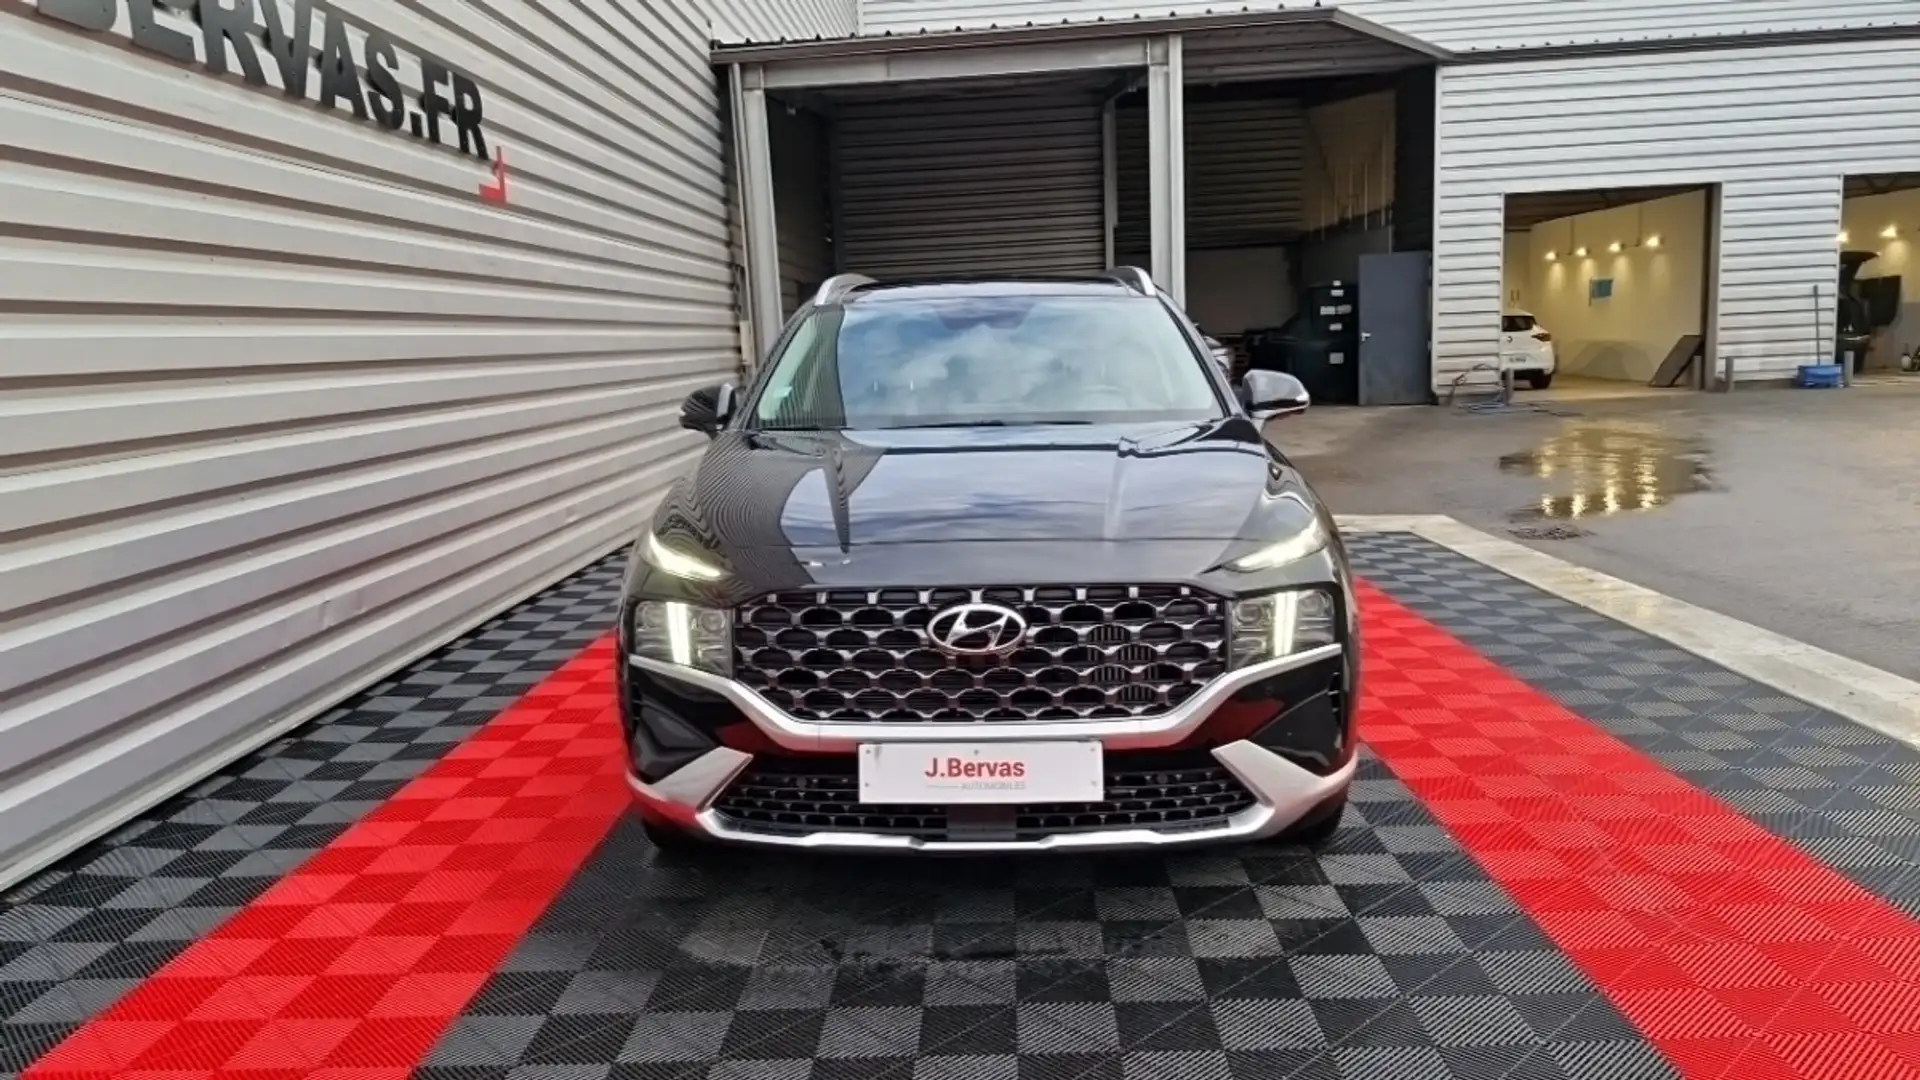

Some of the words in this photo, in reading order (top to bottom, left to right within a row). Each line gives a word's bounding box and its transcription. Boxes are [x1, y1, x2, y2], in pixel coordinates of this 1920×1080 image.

[36, 0, 489, 160] ERVAS.FR
[924, 757, 1025, 778] J.Bervas
[961, 781, 1026, 790] AUTOMOBILES
